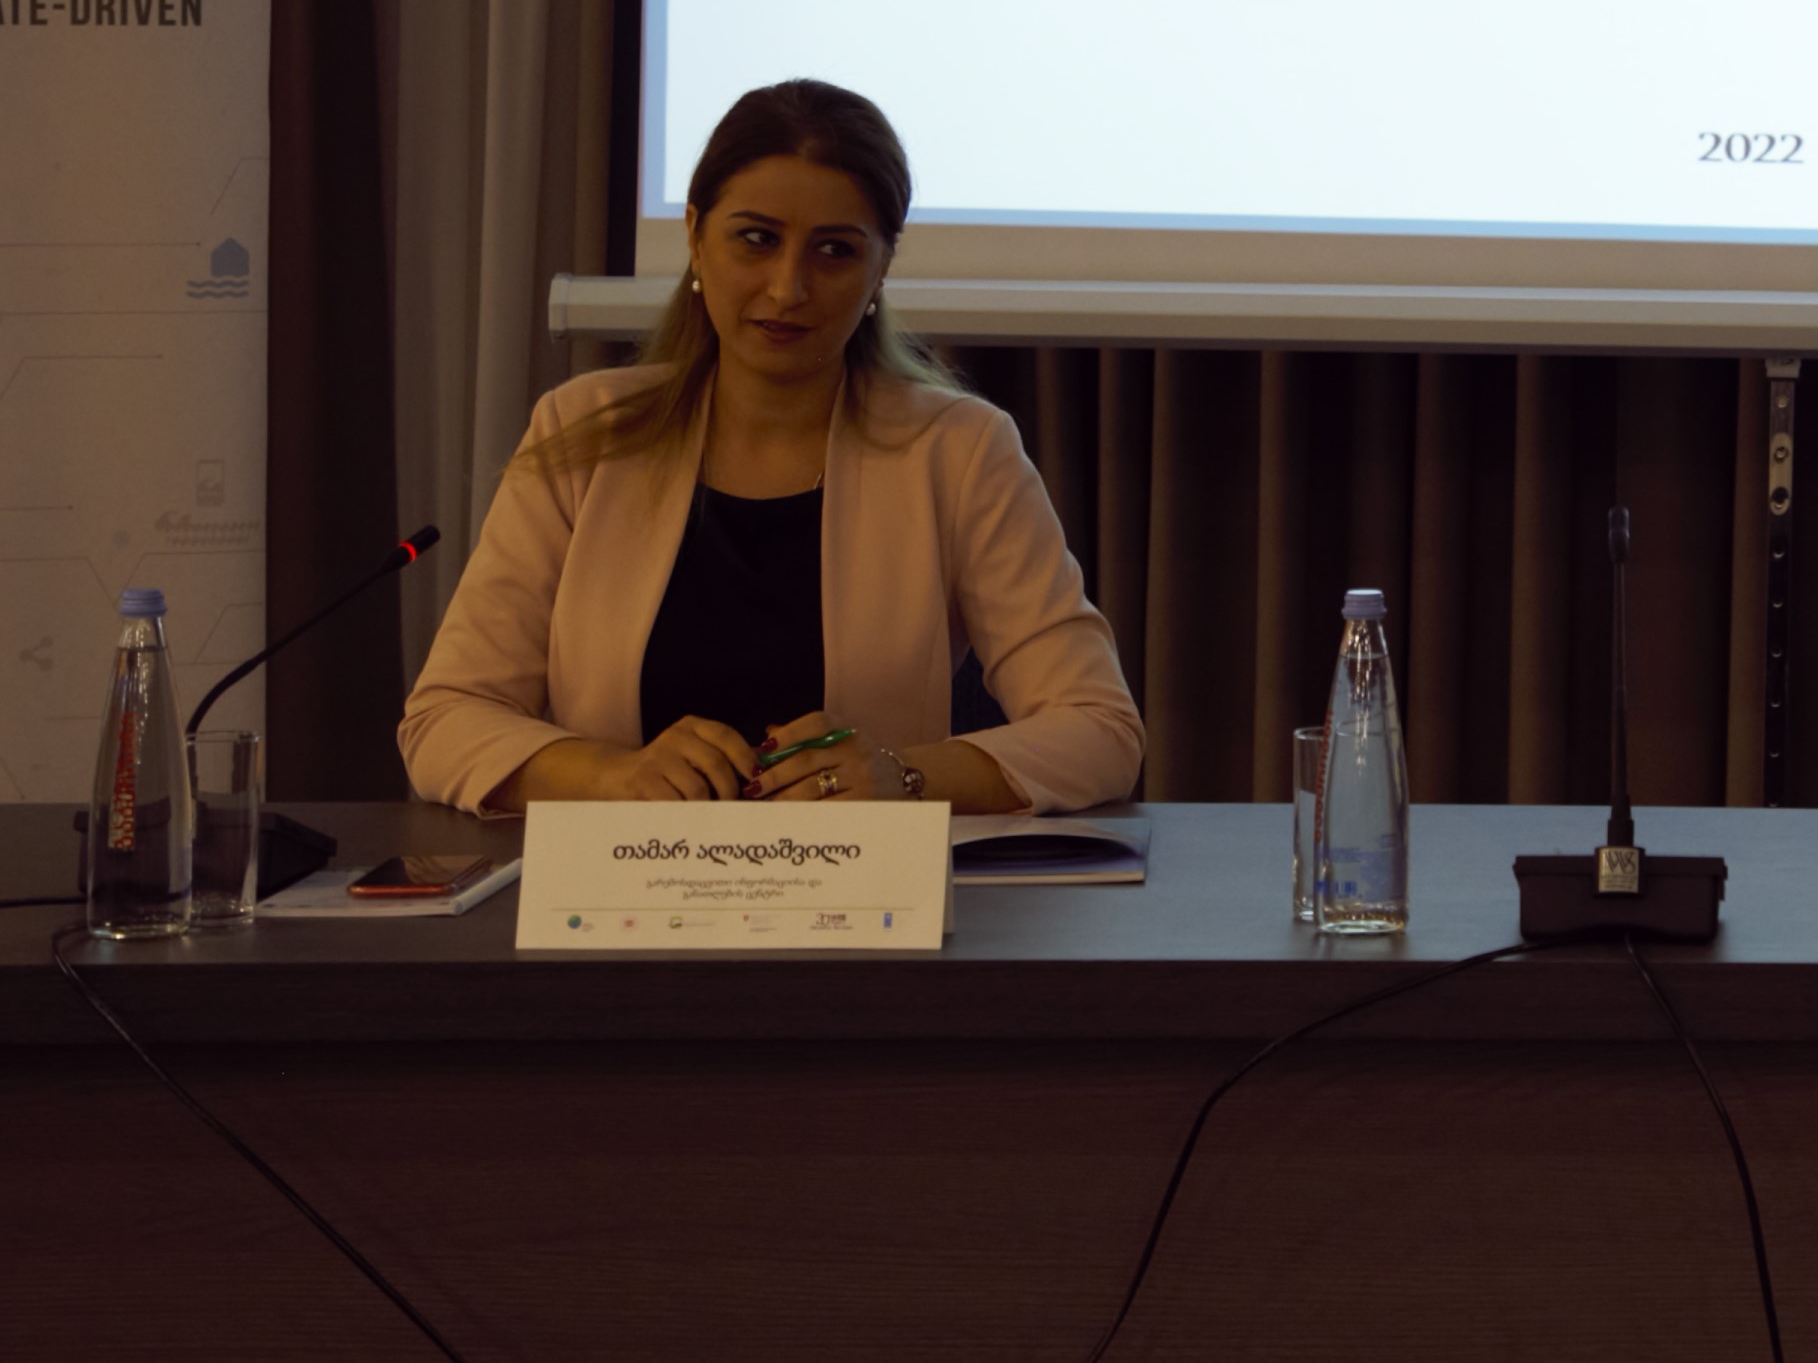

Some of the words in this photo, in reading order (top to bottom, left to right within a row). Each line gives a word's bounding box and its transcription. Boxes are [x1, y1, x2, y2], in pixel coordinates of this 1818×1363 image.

[1698, 132, 1804, 164] 2022
[612, 838, 690, 860] თამარ
[696, 838, 861, 866] ალადაშვილი
